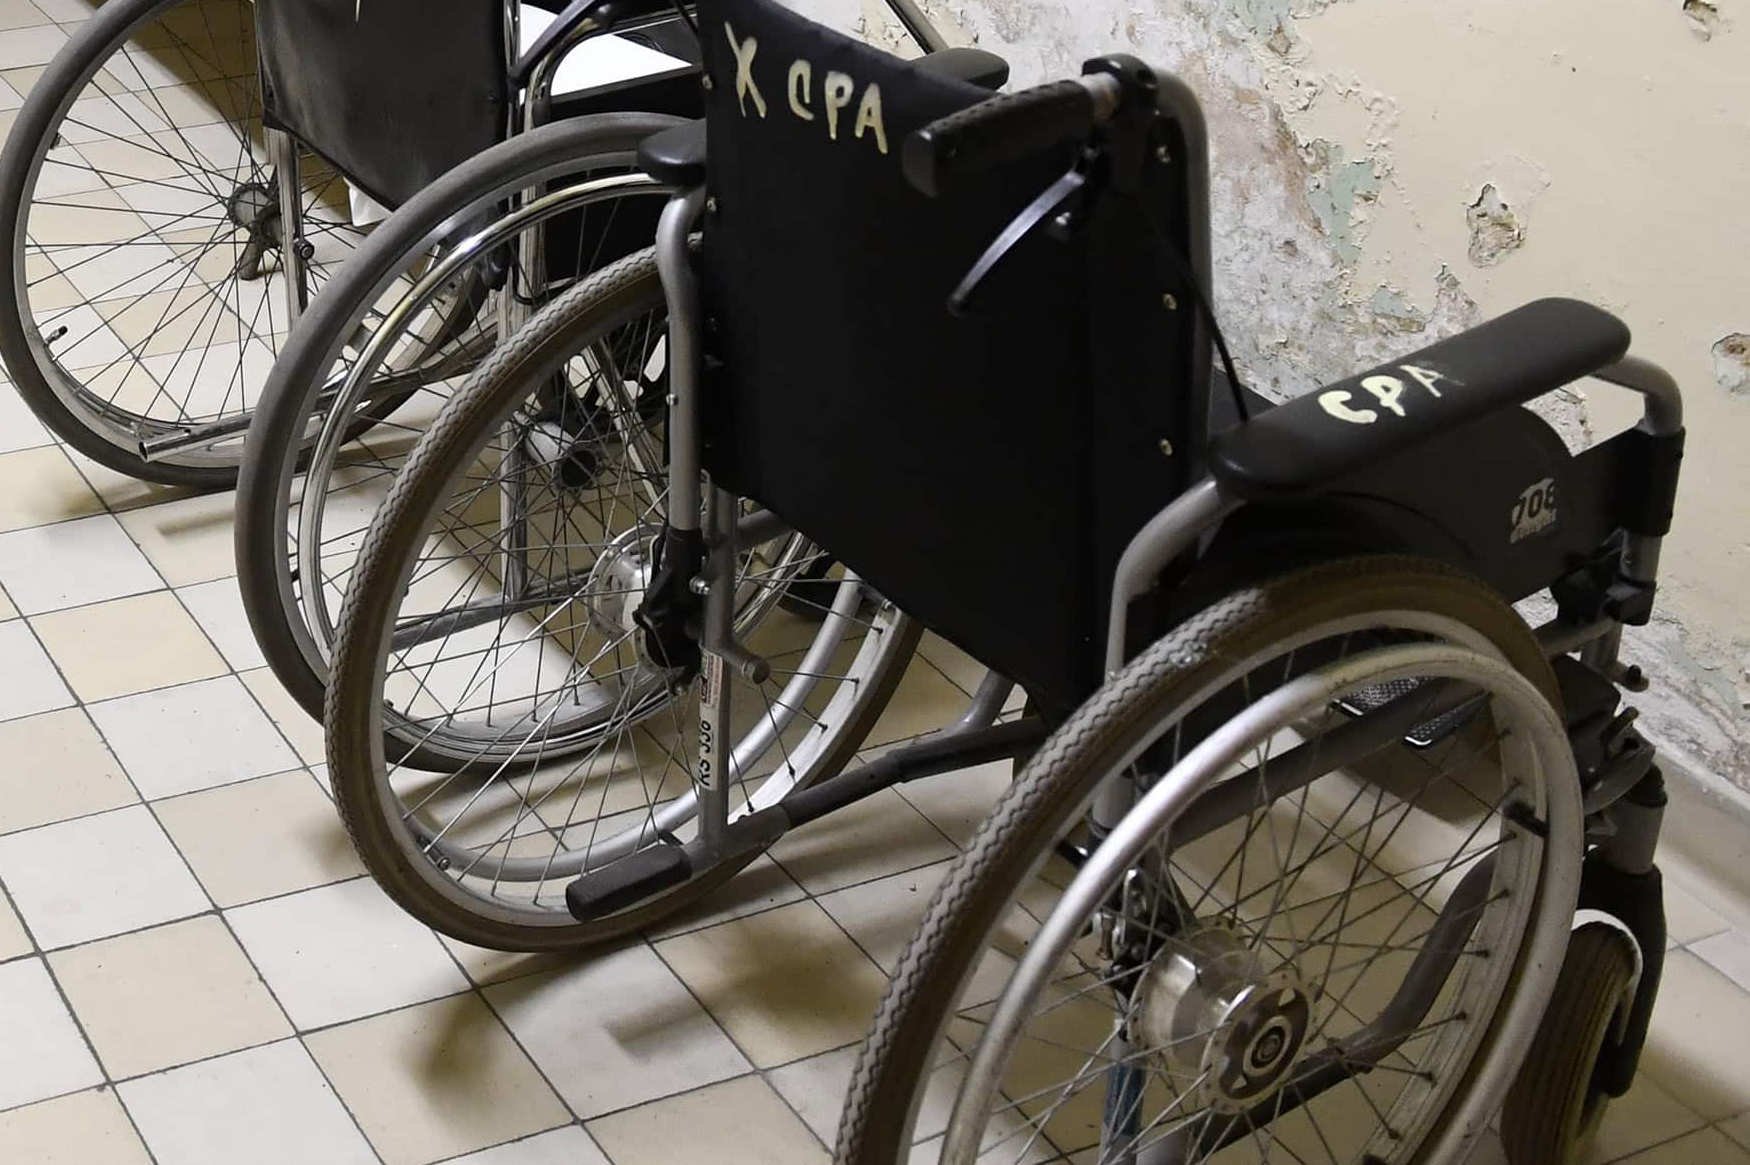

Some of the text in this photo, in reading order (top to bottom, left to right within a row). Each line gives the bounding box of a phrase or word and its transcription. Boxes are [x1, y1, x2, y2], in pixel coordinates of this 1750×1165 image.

[724, 21, 890, 155] X CPA
[1317, 361, 1465, 425] CPA
